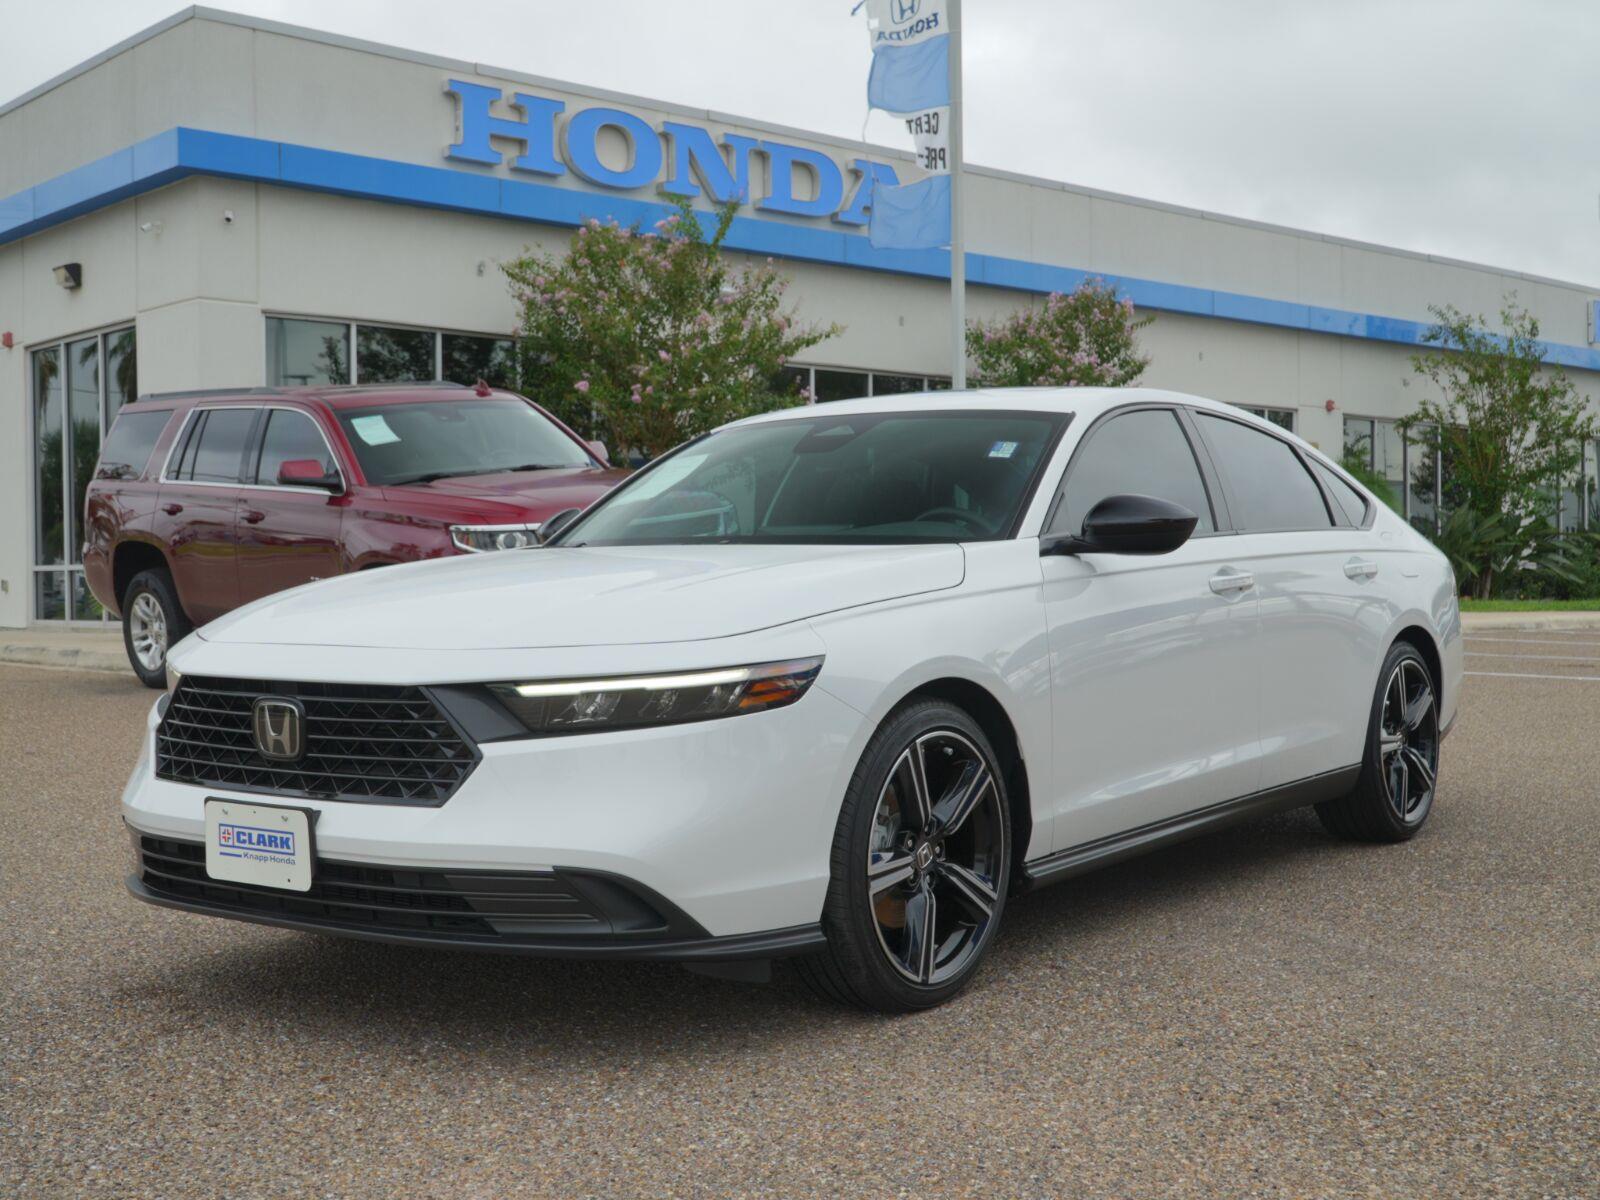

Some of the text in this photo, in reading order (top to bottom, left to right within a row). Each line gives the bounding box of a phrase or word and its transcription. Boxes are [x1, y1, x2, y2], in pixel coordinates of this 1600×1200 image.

[236, 830, 291, 850] CLARK
[243, 851, 296, 866] Knapp Honda
